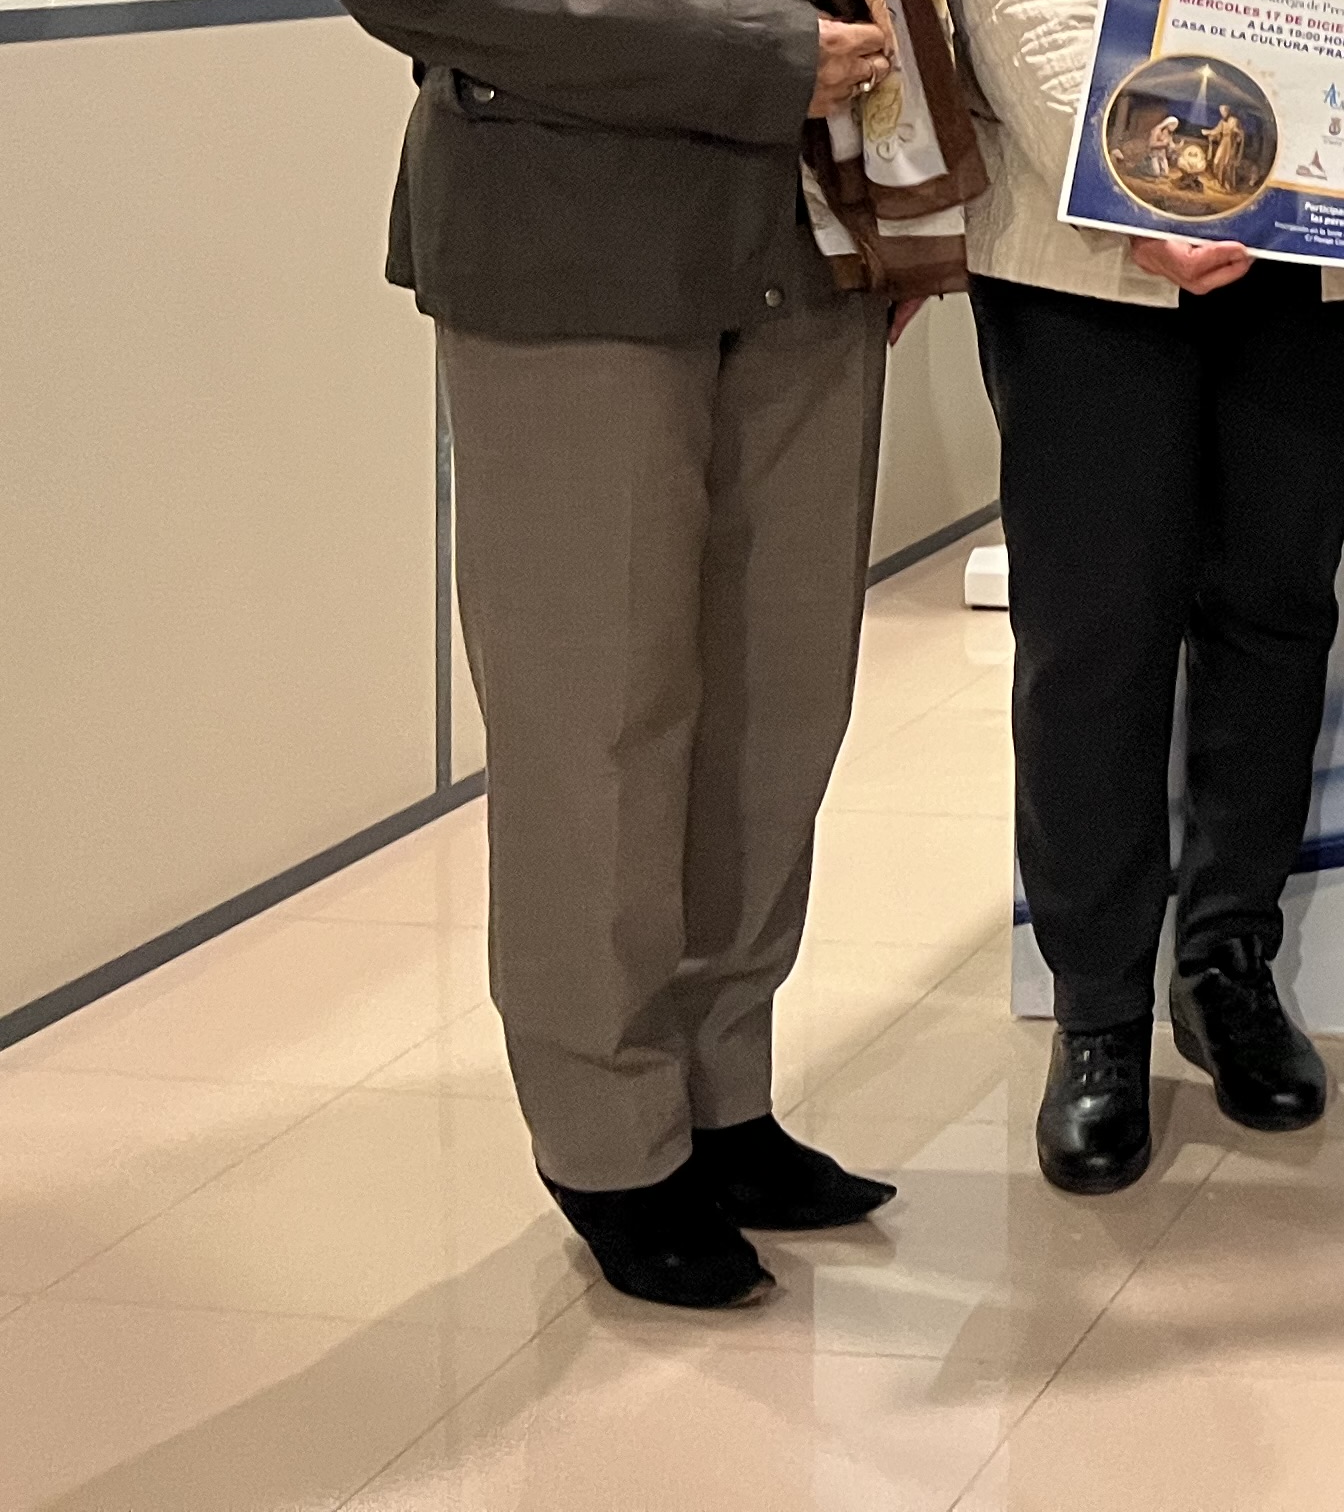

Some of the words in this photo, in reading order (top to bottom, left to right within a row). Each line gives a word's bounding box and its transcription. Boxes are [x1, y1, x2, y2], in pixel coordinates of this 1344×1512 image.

[1171, 18, 1206, 33] CASA
[1250, 33, 1309, 52] CULTURA
[1259, 22, 1283, 35] LAS
